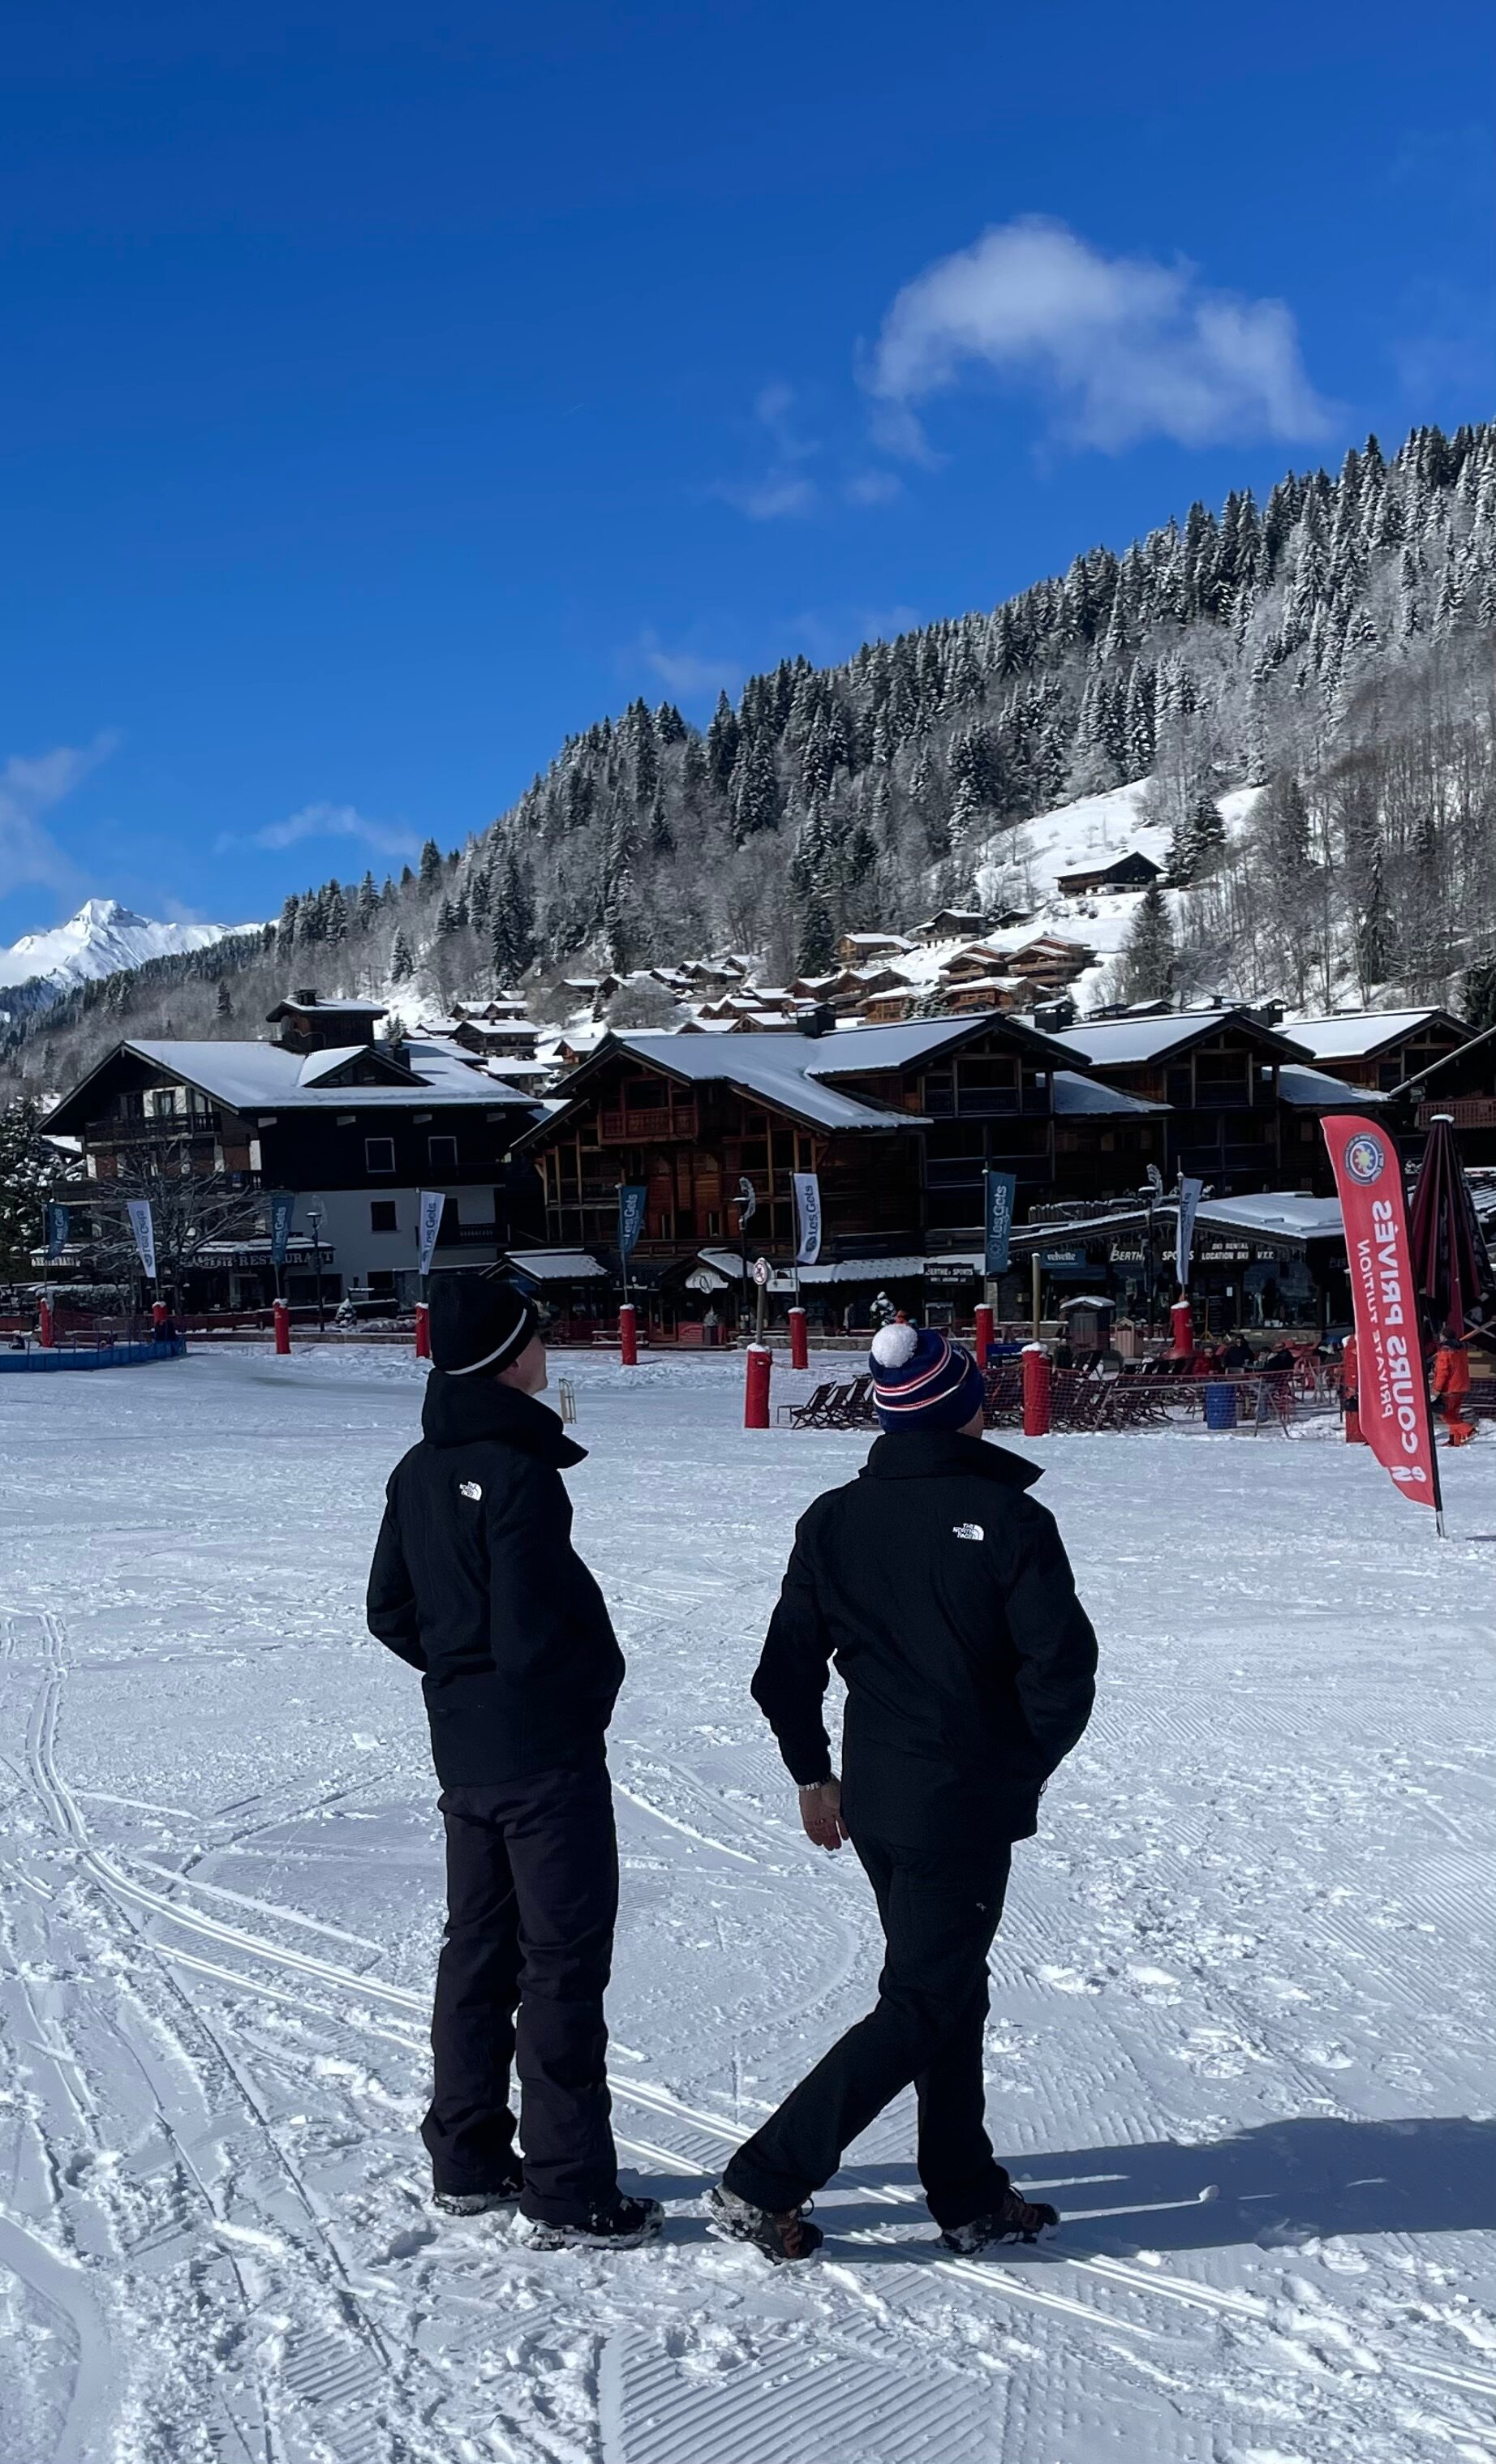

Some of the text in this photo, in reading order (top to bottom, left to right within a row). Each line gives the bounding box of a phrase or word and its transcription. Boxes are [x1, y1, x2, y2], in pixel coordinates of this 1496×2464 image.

[804, 1185, 818, 1234] Les Gets
[994, 1185, 1007, 1215] Gets
[426, 1202, 436, 1228] Gets
[990, 1217, 1004, 1238] Les
[1202, 1251, 1234, 1260] LOCATION
